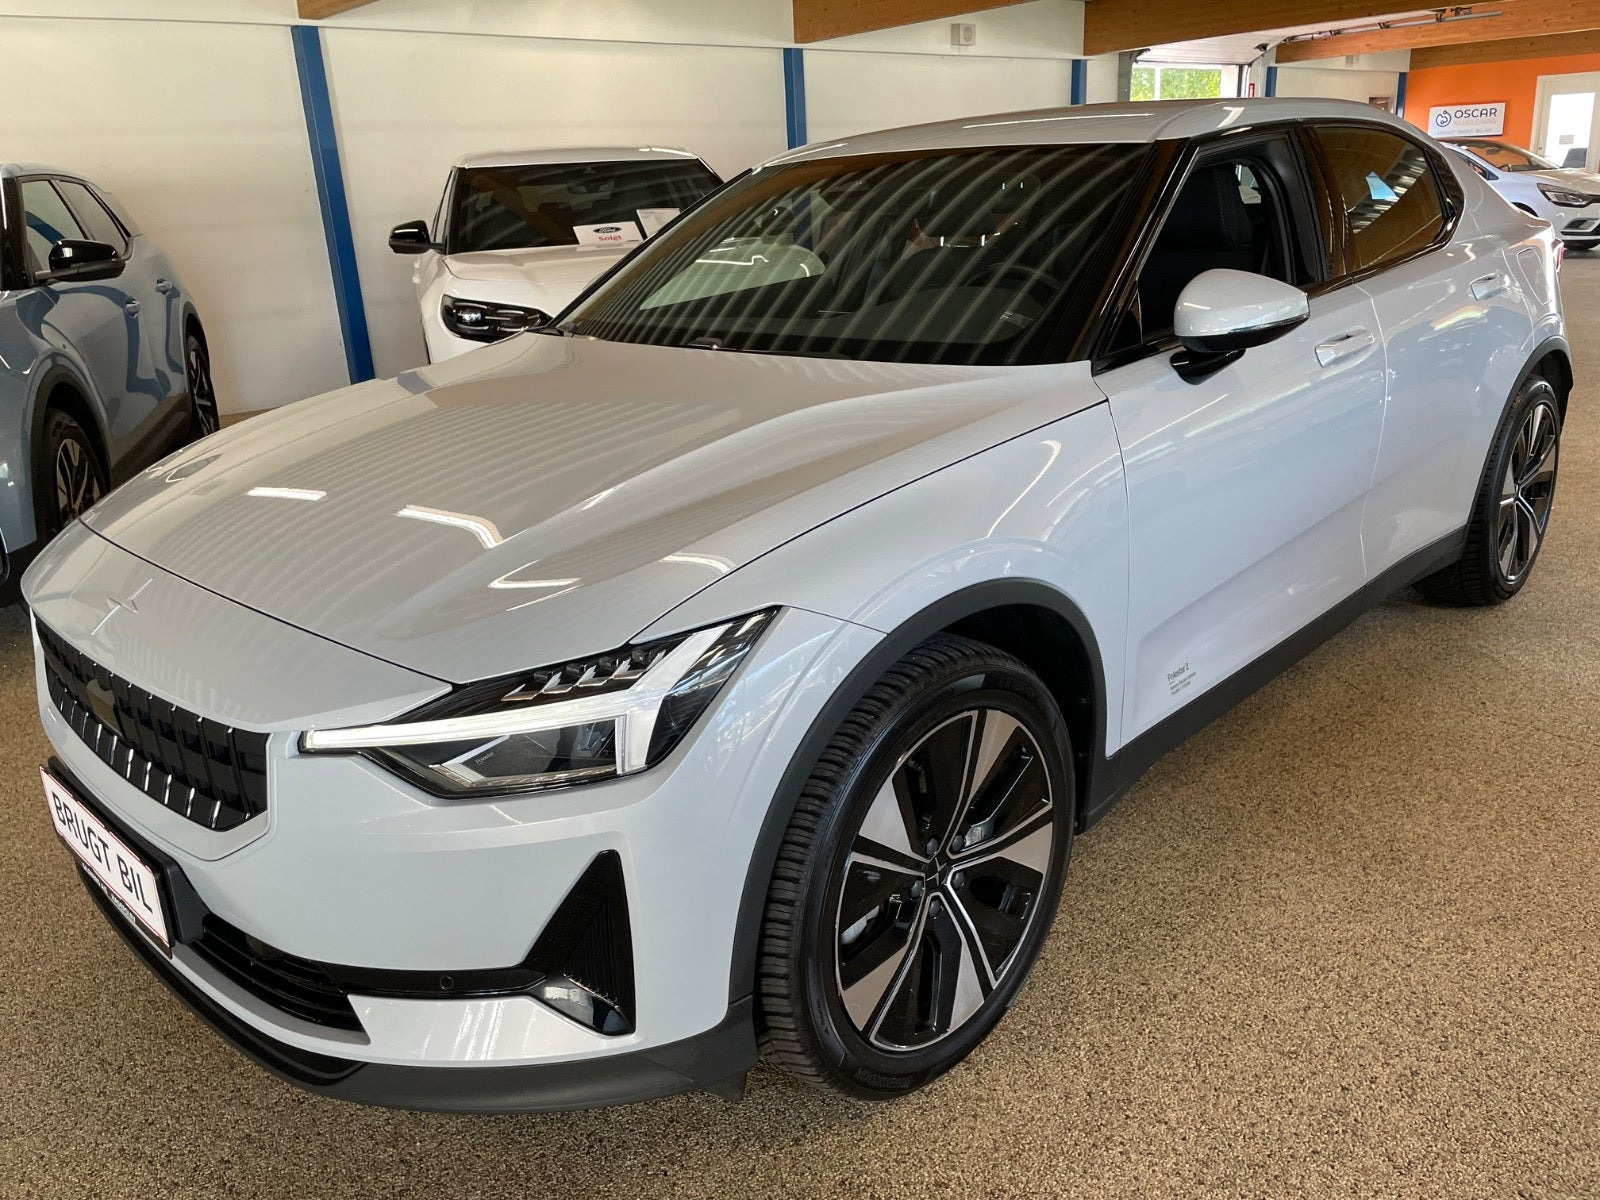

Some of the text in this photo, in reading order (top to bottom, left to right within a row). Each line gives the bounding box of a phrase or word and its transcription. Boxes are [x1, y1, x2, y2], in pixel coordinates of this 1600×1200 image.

[1454, 108, 1498, 119] OSCAR
[52, 791, 111, 872] BRUGT
[116, 853, 153, 914] BIL
